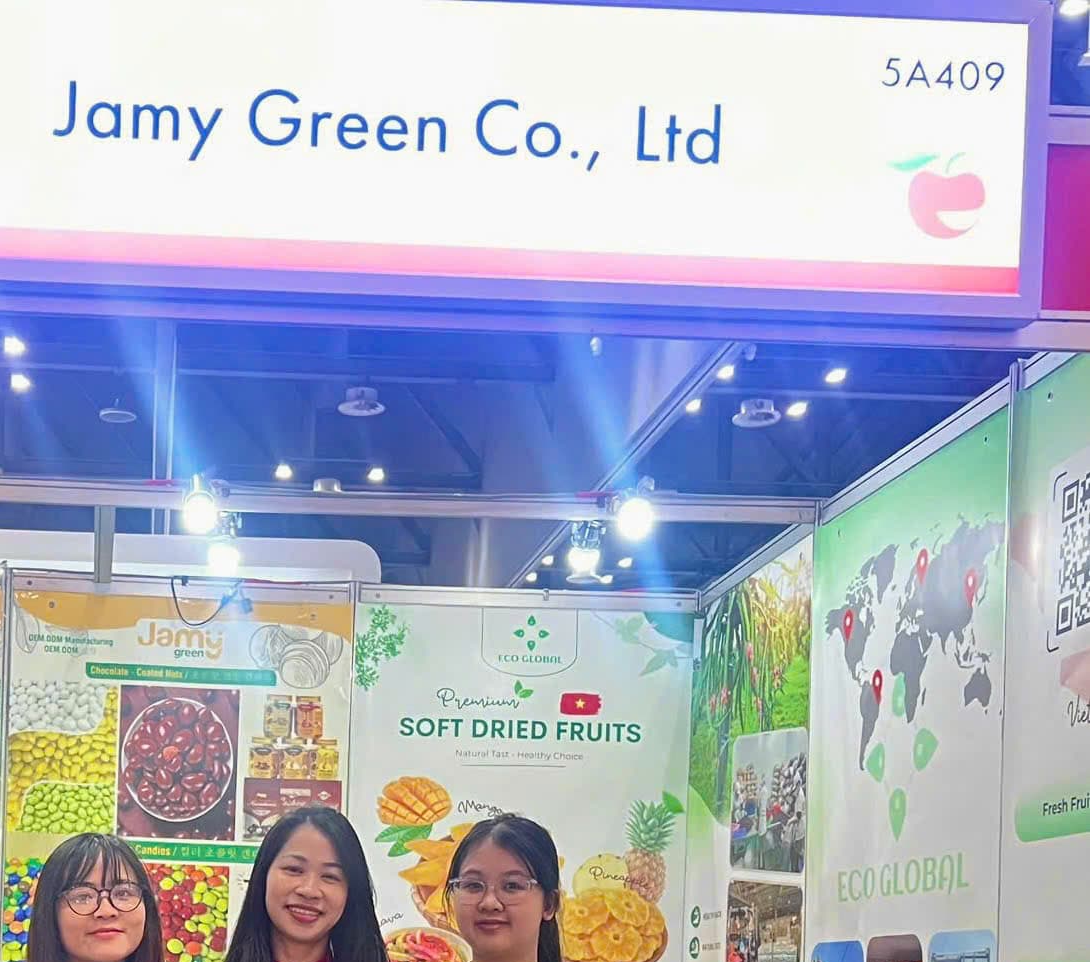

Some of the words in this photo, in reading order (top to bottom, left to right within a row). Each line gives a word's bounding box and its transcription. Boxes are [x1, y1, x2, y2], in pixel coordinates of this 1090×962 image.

[882, 57, 1006, 93] 5A409
[53, 81, 222, 160] Jamy
[248, 89, 448, 155] Green
[476, 99, 601, 172] Co.,
[636, 104, 723, 166] Ltd
[137, 622, 223, 660] Jamy
[174, 648, 204, 659] green
[498, 654, 519, 664] ECO
[522, 654, 563, 664] GLOBAL
[90, 664, 128, 677] Chocolate
[136, 668, 164, 678] Coated
[436, 687, 520, 709] Premium
[400, 717, 464, 738] SOFT
[472, 719, 548, 740] DRIED
[556, 721, 642, 742] FRUITS
[455, 749, 490, 759] Natural
[517, 750, 551, 761] Healthy
[553, 751, 584, 761] Choice
[1042, 798, 1068, 817] Fresh
[837, 864, 875, 903] ECO
[880, 852, 970, 898] GLOBAL
